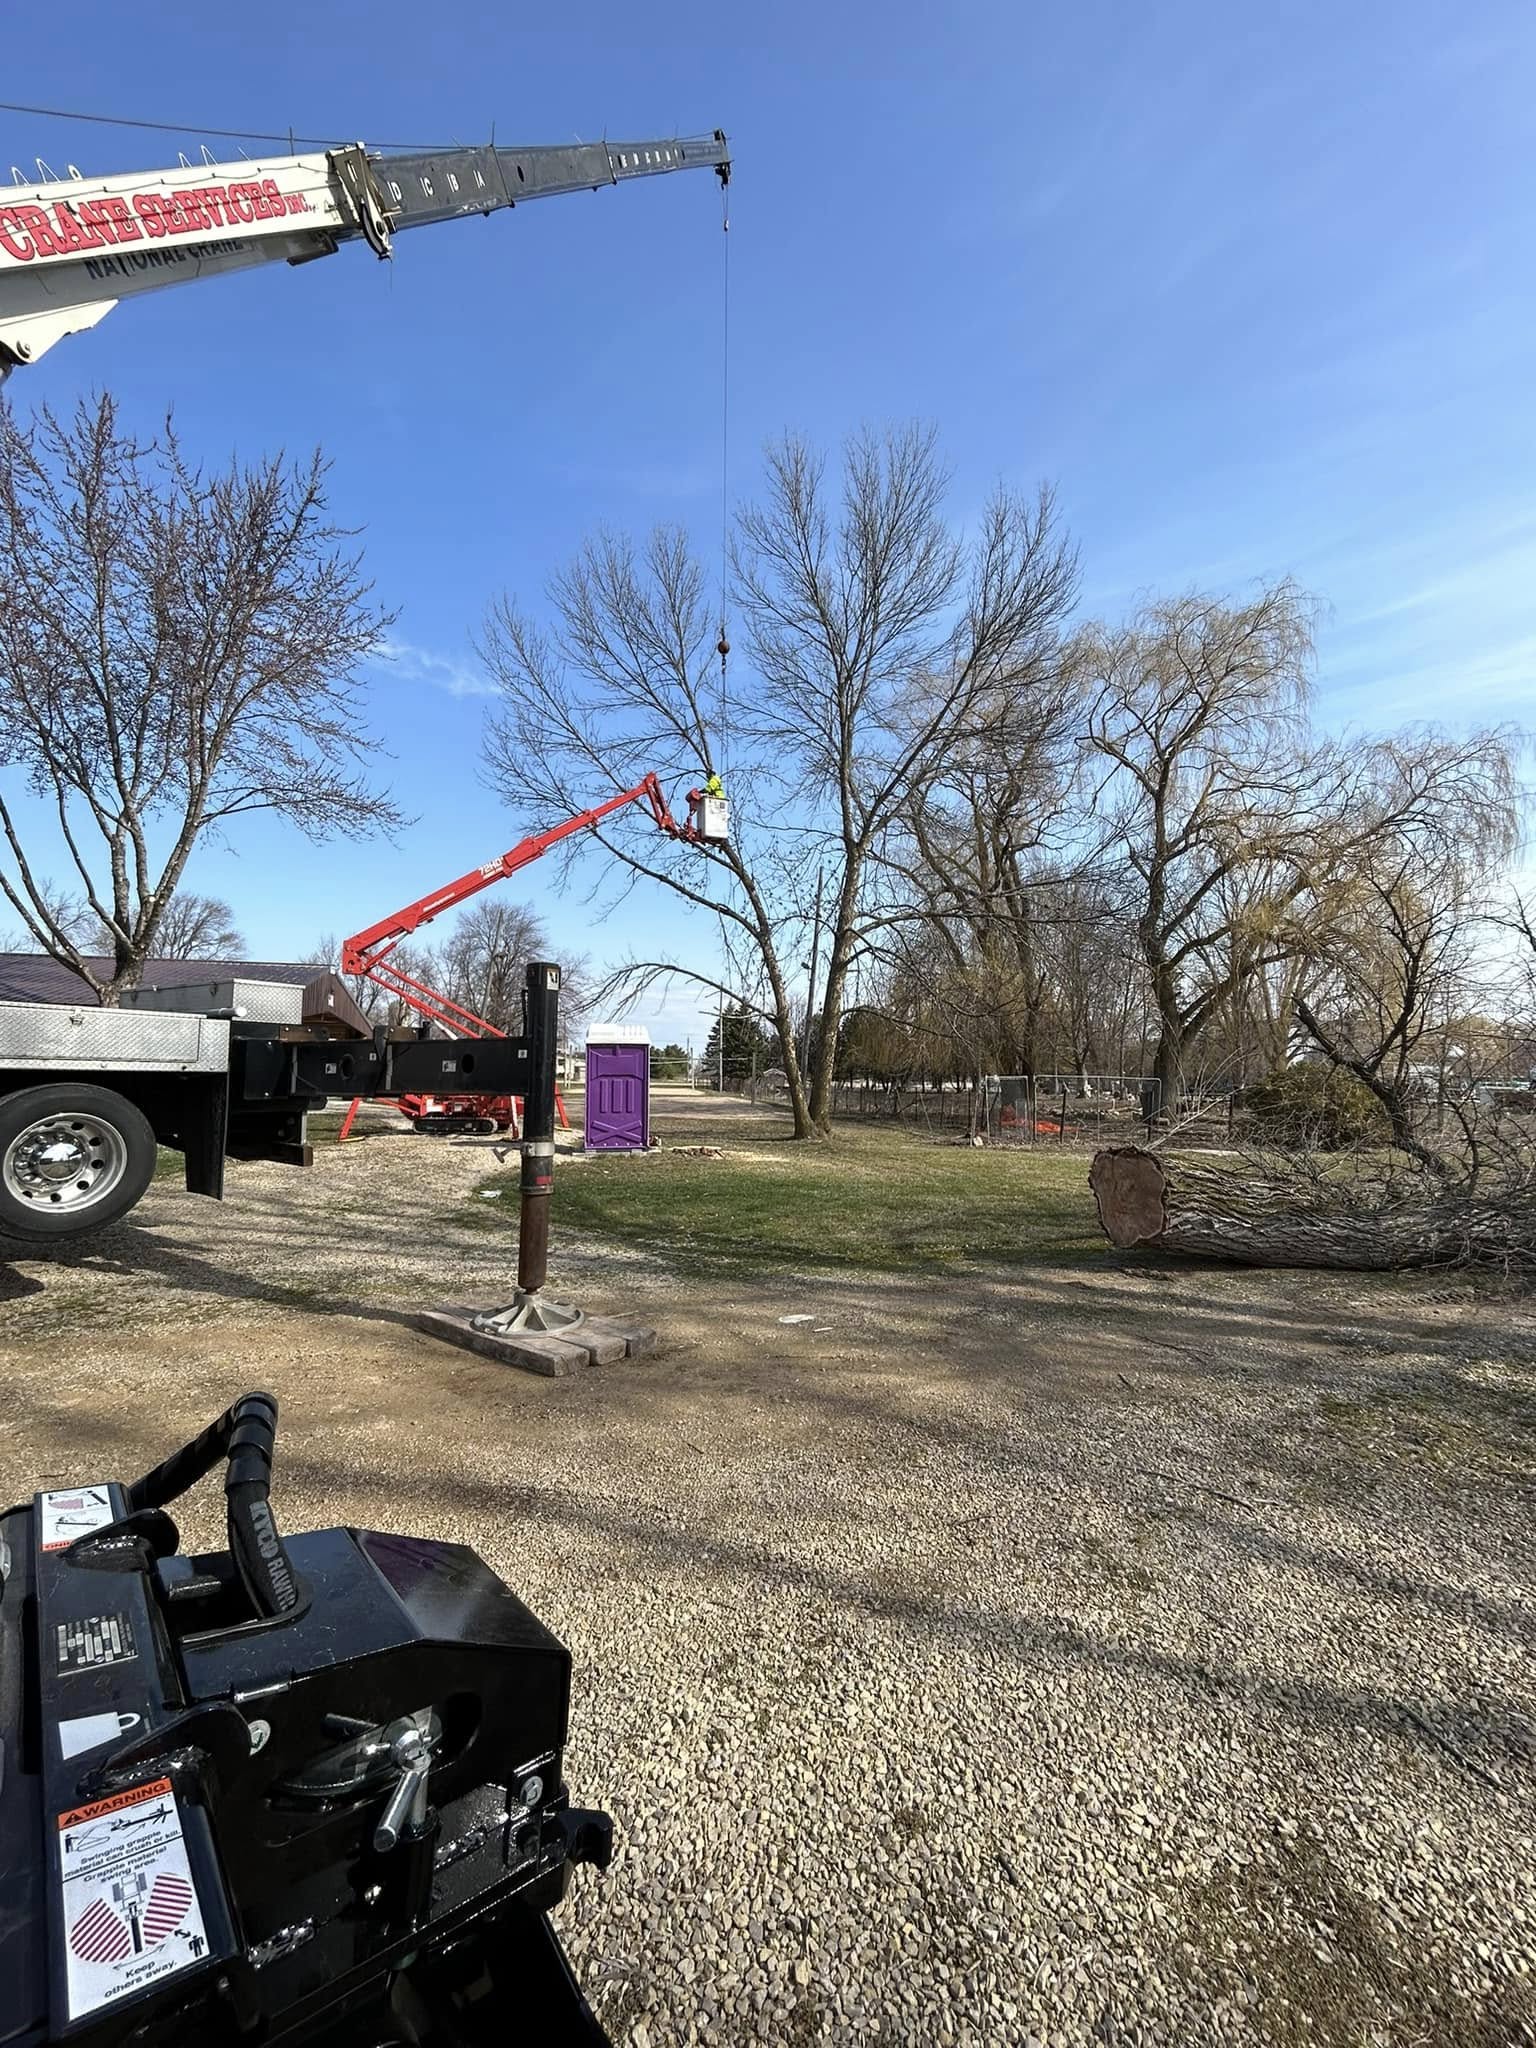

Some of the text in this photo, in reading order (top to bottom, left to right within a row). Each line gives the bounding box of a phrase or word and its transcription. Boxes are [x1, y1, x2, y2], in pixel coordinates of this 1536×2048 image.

[0, 197, 144, 261] CRANE
[133, 178, 287, 238] SERVICES
[85, 246, 187, 280] NATIONAL
[83, 1783, 167, 1818] WARNING
[64, 1829, 181, 1878] material can crush or kill.
[80, 1831, 162, 1865] Swinging grapple
[83, 1846, 168, 1883] Grapple material
[100, 1866, 132, 1884] swing
[104, 1960, 178, 1998] others away.
[125, 1961, 155, 1978] Keep
